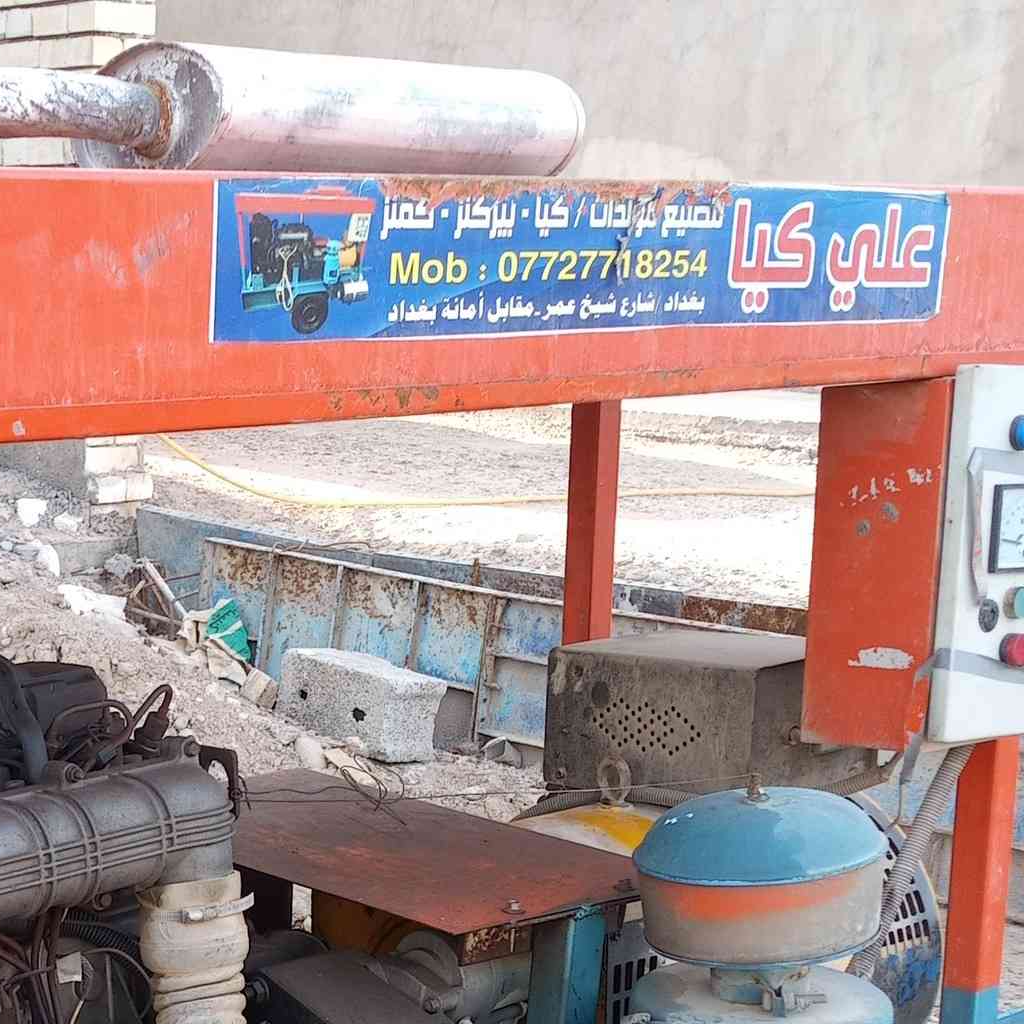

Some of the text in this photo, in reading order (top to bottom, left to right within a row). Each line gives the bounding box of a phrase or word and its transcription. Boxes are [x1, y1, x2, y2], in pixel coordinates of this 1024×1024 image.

[534, 194, 570, 238] كيا
[389, 251, 468, 285] Mob
[497, 249, 708, 283] 07727718254
[728, 198, 935, 314] علي كيا
[388, 298, 437, 325] بغداد
[441, 290, 485, 320] أمانة
[487, 295, 534, 323] مقابل
[541, 299, 576, 321] عمر
[579, 293, 616, 320] شيخ
[619, 291, 655, 319] شارع
[663, 290, 705, 315] بغداد
